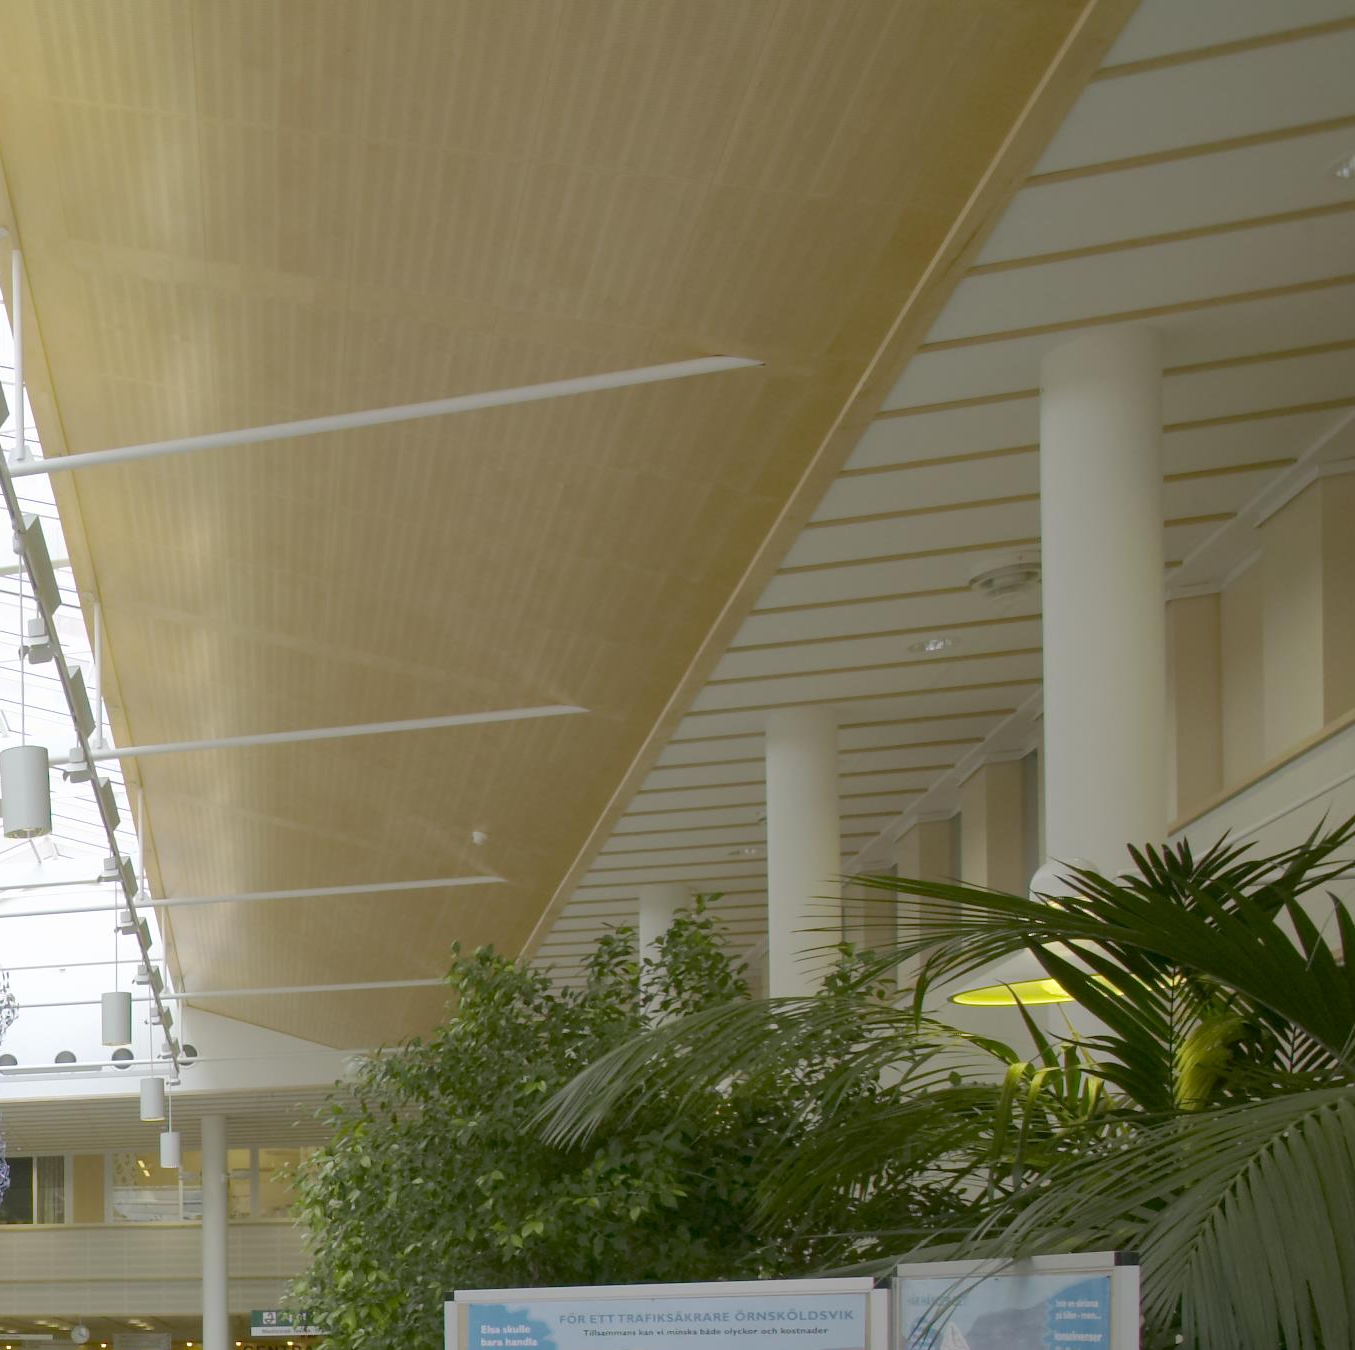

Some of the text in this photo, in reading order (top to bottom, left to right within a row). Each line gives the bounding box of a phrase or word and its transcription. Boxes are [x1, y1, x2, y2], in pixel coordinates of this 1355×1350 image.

[559, 1308, 855, 1325] FÖR ETT TRAFIKSÄKRARE ÖRNSKÖLDSVIK
[480, 1324, 531, 1334] Elsa skulle
[583, 1329, 636, 1337] Tillsammans
[666, 1328, 698, 1336] minska
[724, 1328, 758, 1336] olyckor
[780, 1327, 828, 1335] kostnader
[480, 1336, 539, 1346] bara handla
